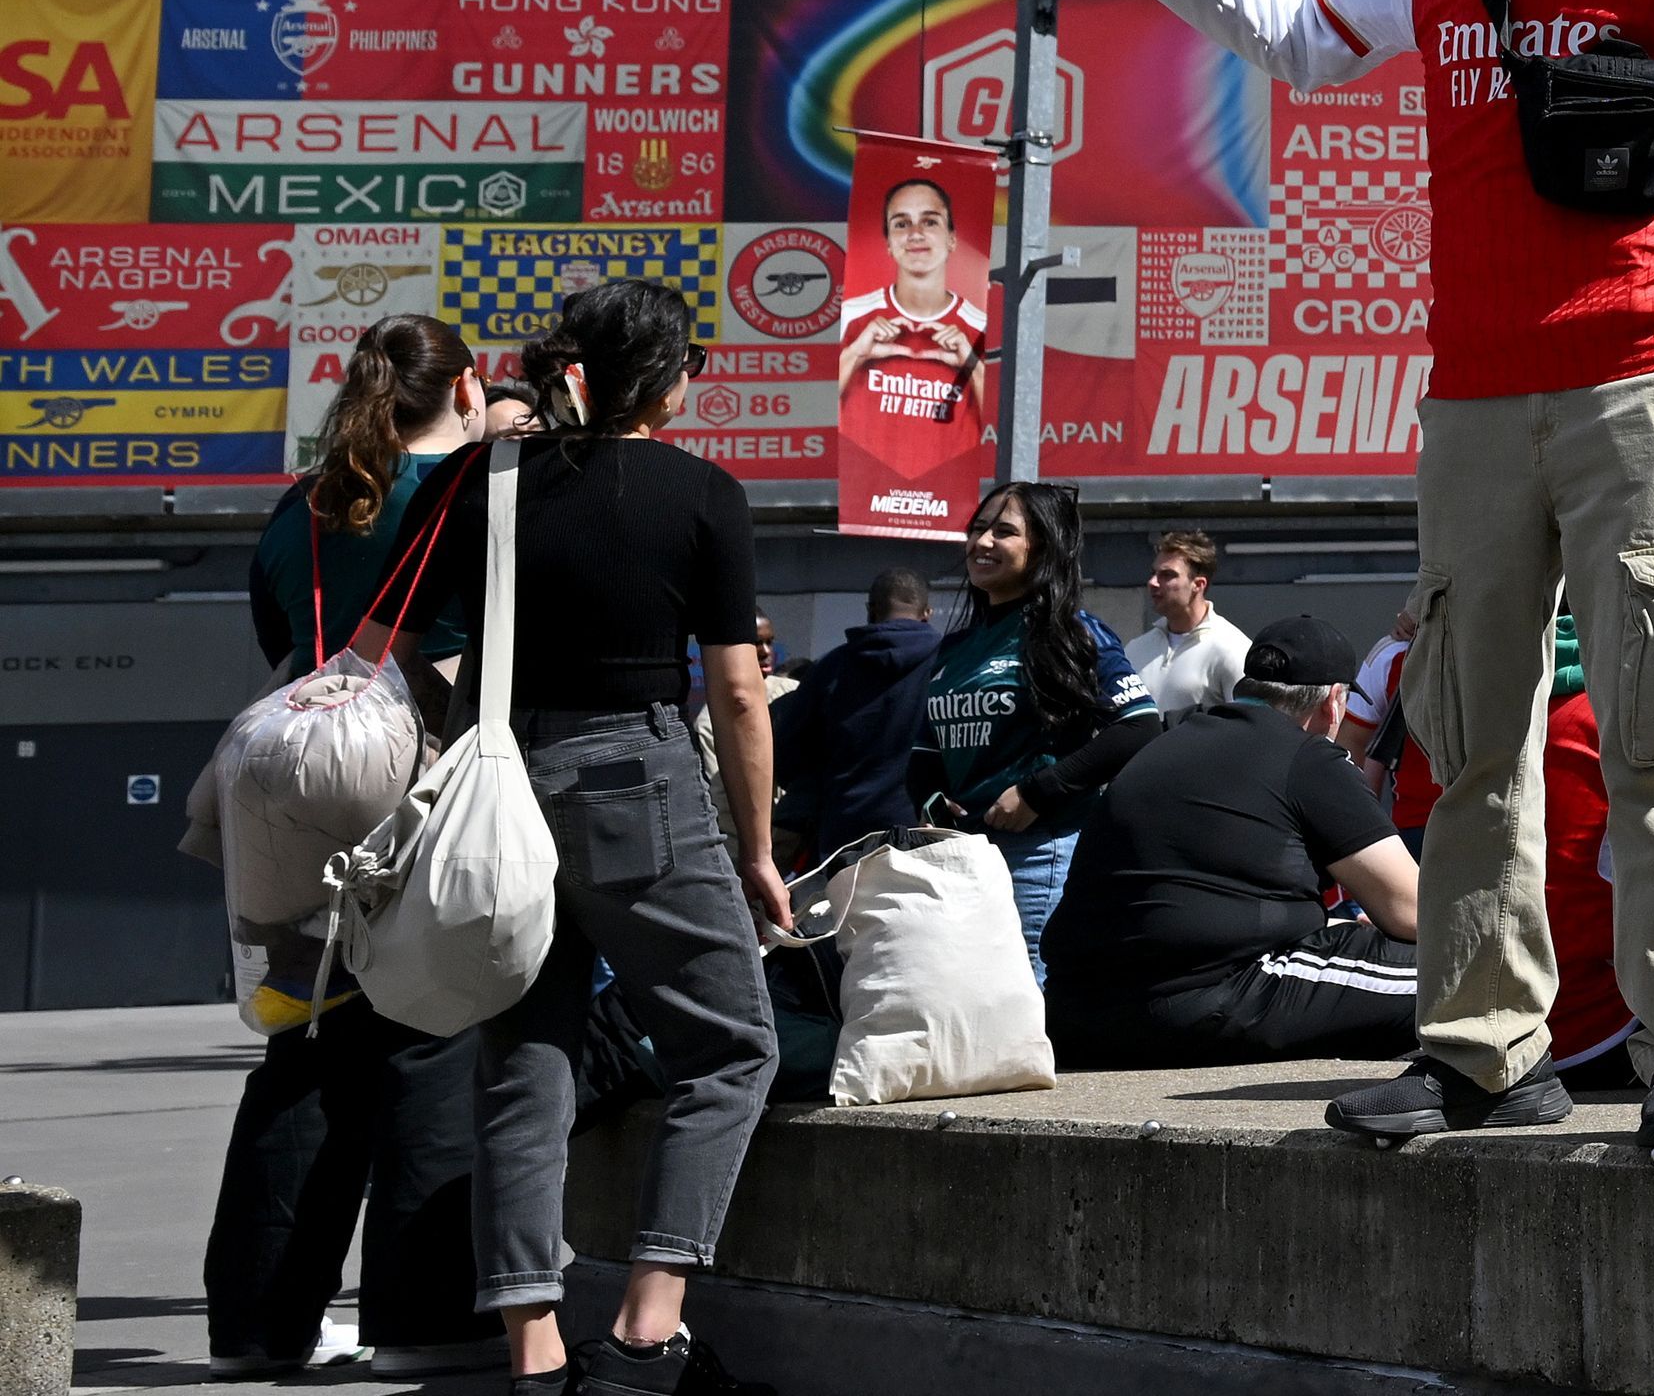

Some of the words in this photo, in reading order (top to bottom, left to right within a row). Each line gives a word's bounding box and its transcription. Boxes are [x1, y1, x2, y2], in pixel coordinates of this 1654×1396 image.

[182, 28, 247, 50] ARSENAL
[349, 30, 437, 51] PHILIPPINES
[452, 63, 720, 95] GUNNERS
[1452, 67, 1481, 108] FLY
[595, 109, 718, 132] WOOLWICH
[598, 153, 623, 174] 18
[681, 153, 715, 173] 86
[315, 227, 419, 246] OMAGH
[81, 355, 272, 383] WALES
[868, 370, 962, 402] Emirates
[155, 406, 224, 419] CYMRU
[880, 396, 901, 414] FLY
[904, 399, 948, 421] BETTER
[890, 489, 933, 499] VIVIANNE
[870, 495, 948, 517] MIEDEMA
[75, 654, 135, 670] END
[950, 721, 992, 749] BETTER
